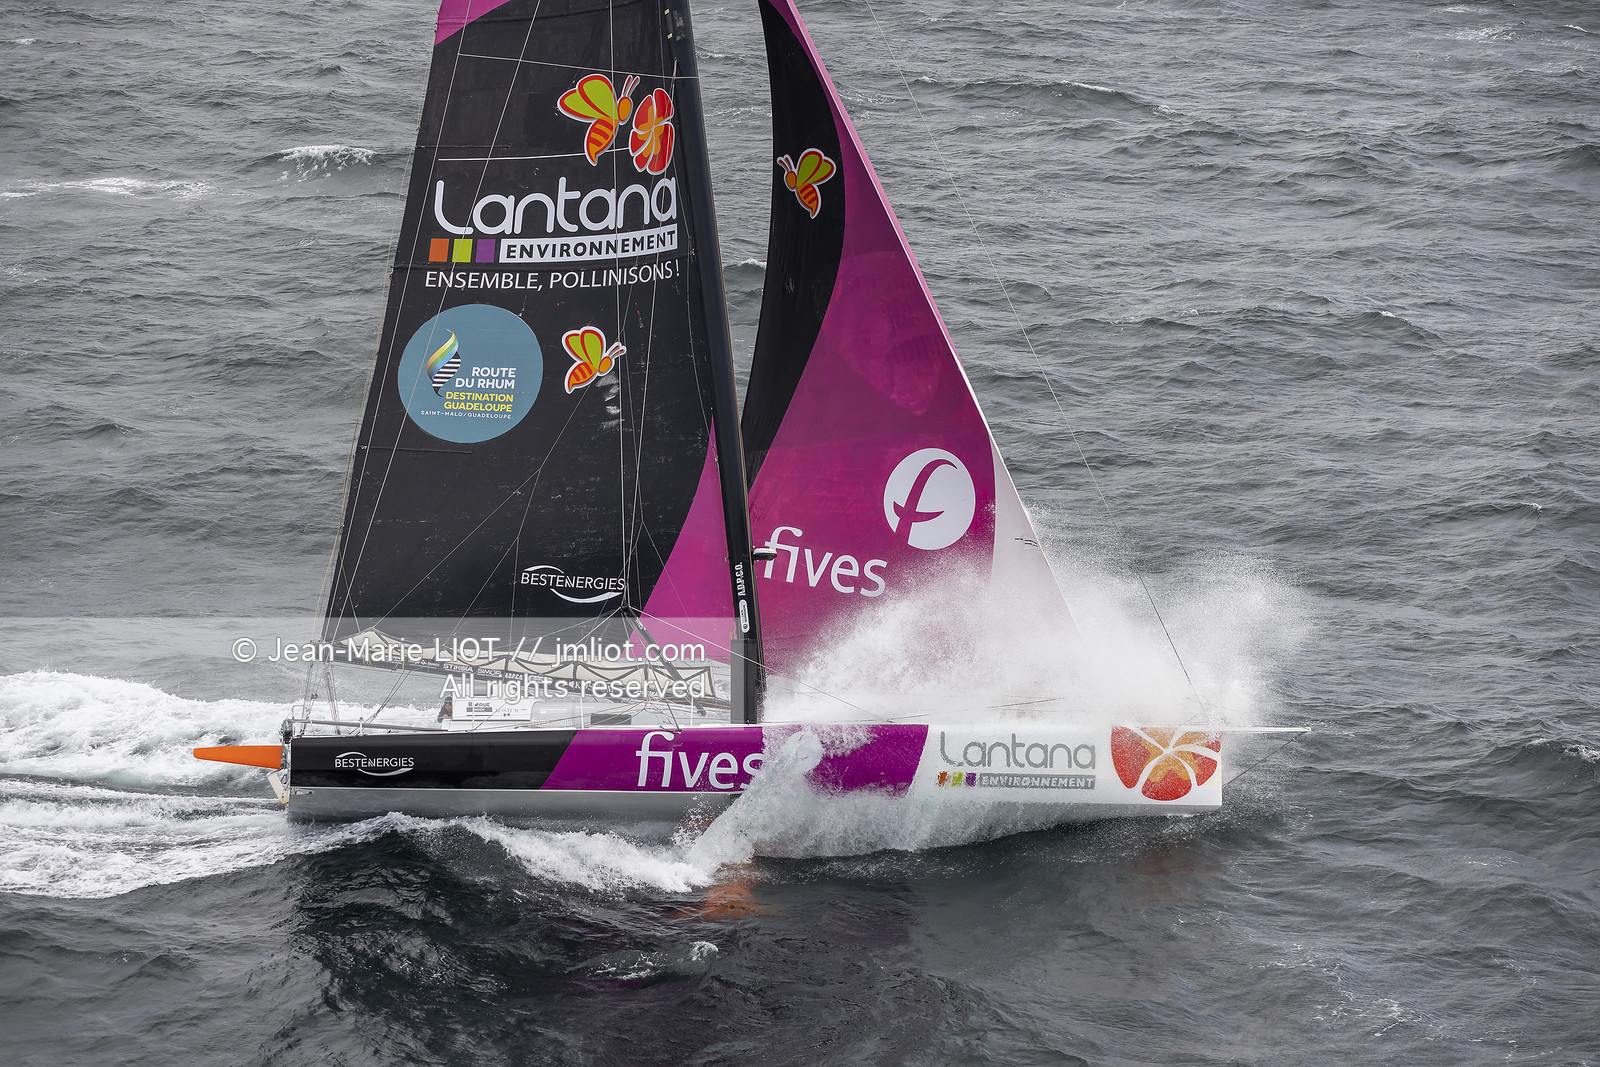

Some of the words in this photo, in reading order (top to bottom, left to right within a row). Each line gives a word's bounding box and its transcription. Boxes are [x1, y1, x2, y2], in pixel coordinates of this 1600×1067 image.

[434, 177, 677, 235] Lantana
[506, 230, 676, 259] ENVIRONNEMENT
[425, 271, 543, 291] ENSEMBLE,
[472, 367, 516, 378] ROUTE
[455, 378, 474, 388] DU
[477, 379, 515, 389] RHUM
[445, 391, 514, 402] DESTINATION
[444, 401, 512, 412] GUADELOUPE
[764, 526, 887, 598] fives
[520, 572, 626, 590] BESTENERGIES
[940, 731, 1096, 770] Lantana
[334, 757, 415, 768] BESTENERGIES
[981, 775, 1095, 788] ENVIRONNEMENT
